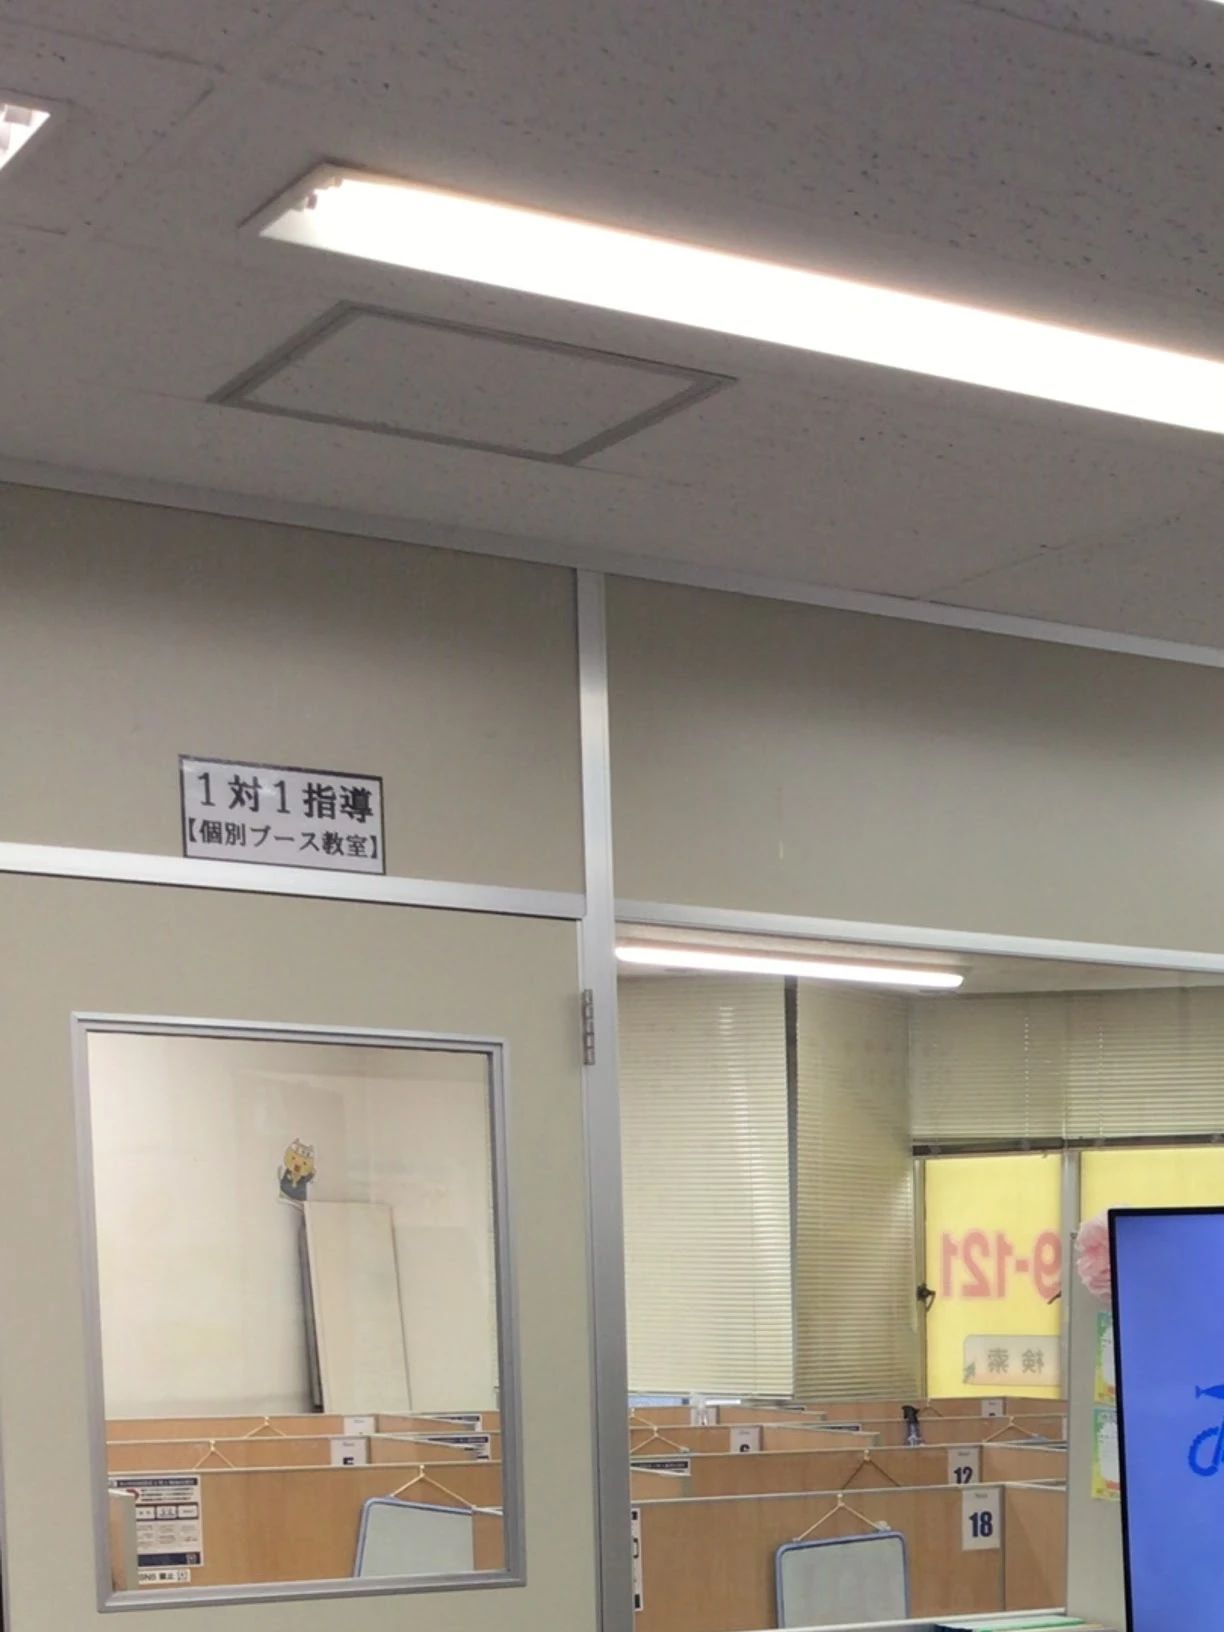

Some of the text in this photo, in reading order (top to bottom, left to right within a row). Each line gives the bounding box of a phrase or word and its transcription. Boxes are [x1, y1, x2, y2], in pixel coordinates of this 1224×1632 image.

[197, 771, 374, 823] 1対1指導
[188, 816, 379, 860] 【個別ブース教室】
[969, 1510, 993, 1538] 18
